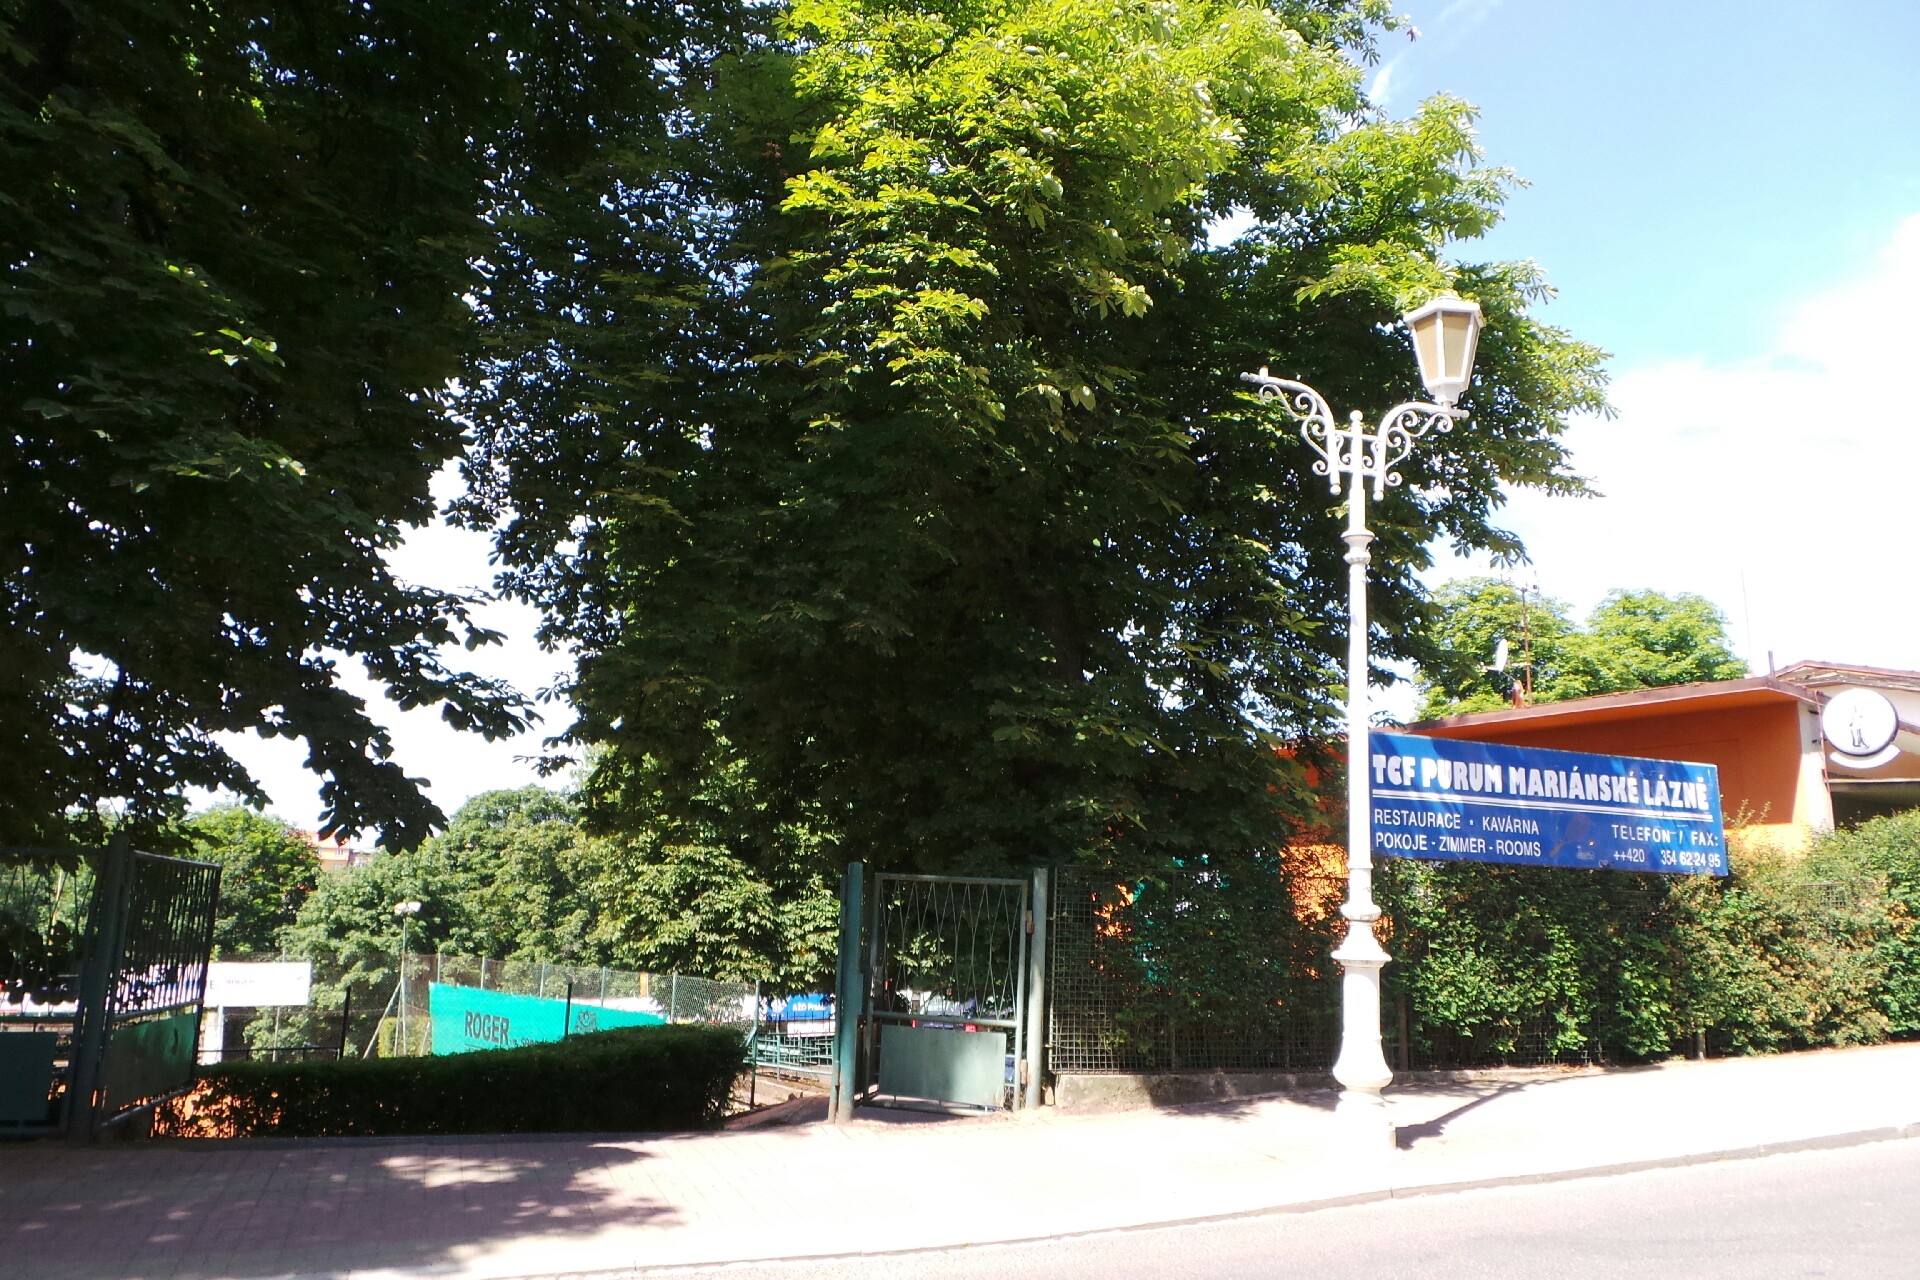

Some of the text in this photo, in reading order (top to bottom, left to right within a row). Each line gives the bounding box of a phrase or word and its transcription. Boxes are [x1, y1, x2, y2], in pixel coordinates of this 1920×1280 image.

[1373, 755, 1710, 811] TCF PURUM MARIÁNSKÉ LÁZNĚ
[1374, 808, 1540, 836] RESTAURACE KAVÁRNA
[1612, 824, 1671, 843] TELEFON
[1691, 831, 1719, 847] FAX:
[1376, 832, 1428, 851] POKOJE
[1439, 836, 1486, 854] ZIMMER
[1496, 840, 1542, 858] ROOMS
[1660, 850, 1677, 866] 354
[1708, 853, 1721, 868] 95
[464, 1010, 510, 1046] ROGER
